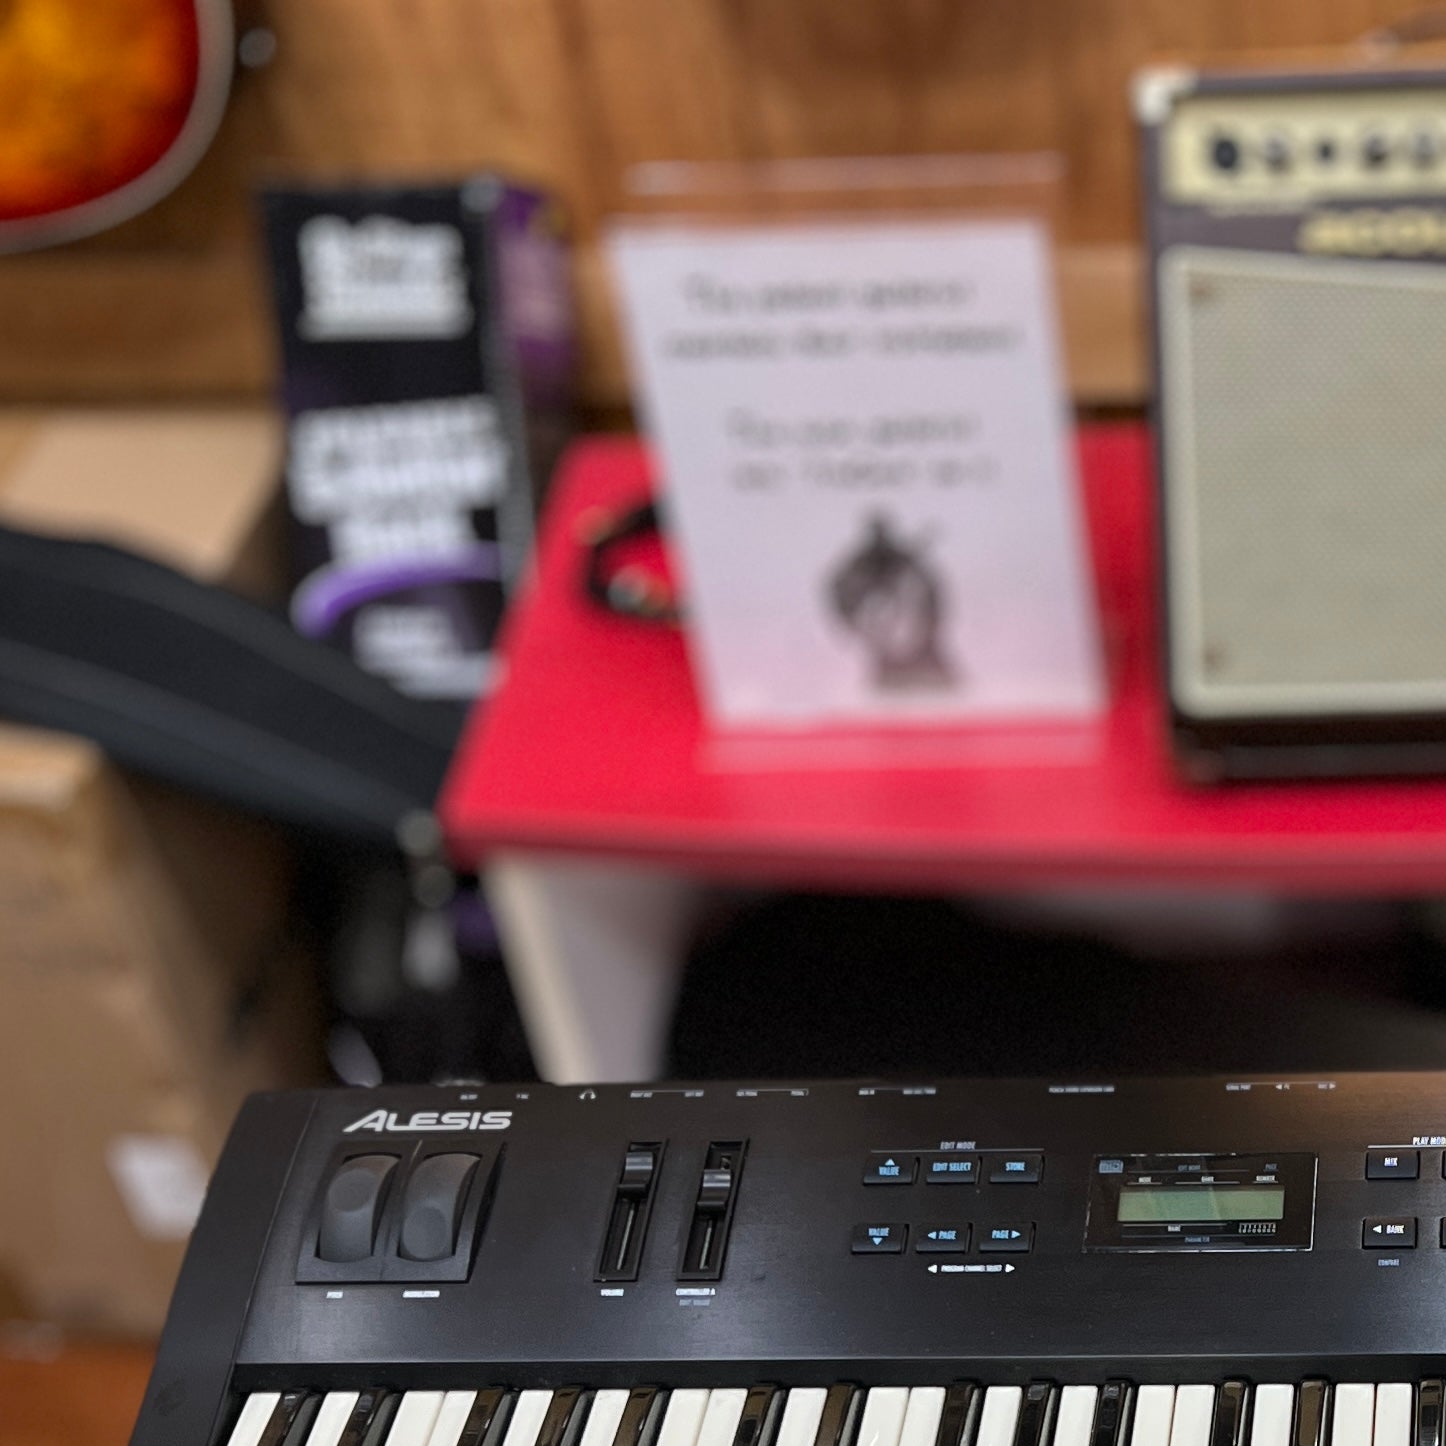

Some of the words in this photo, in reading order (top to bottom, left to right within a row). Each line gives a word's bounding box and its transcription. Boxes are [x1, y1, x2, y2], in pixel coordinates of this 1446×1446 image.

[343, 1109, 513, 1133] ALESIS
[940, 1141, 955, 1150] EDIT
[956, 1141, 976, 1150] MODE
[1412, 1136, 1429, 1146] PLAY
[932, 1162, 948, 1172] EDIT
[949, 1162, 972, 1172] SELECT
[1006, 1162, 1025, 1172] STORE
[1384, 1157, 1399, 1167] MIX
[1386, 1224, 1405, 1234] BANK
[938, 1230, 957, 1240] PAGE
[992, 1230, 1009, 1239] PAGE
